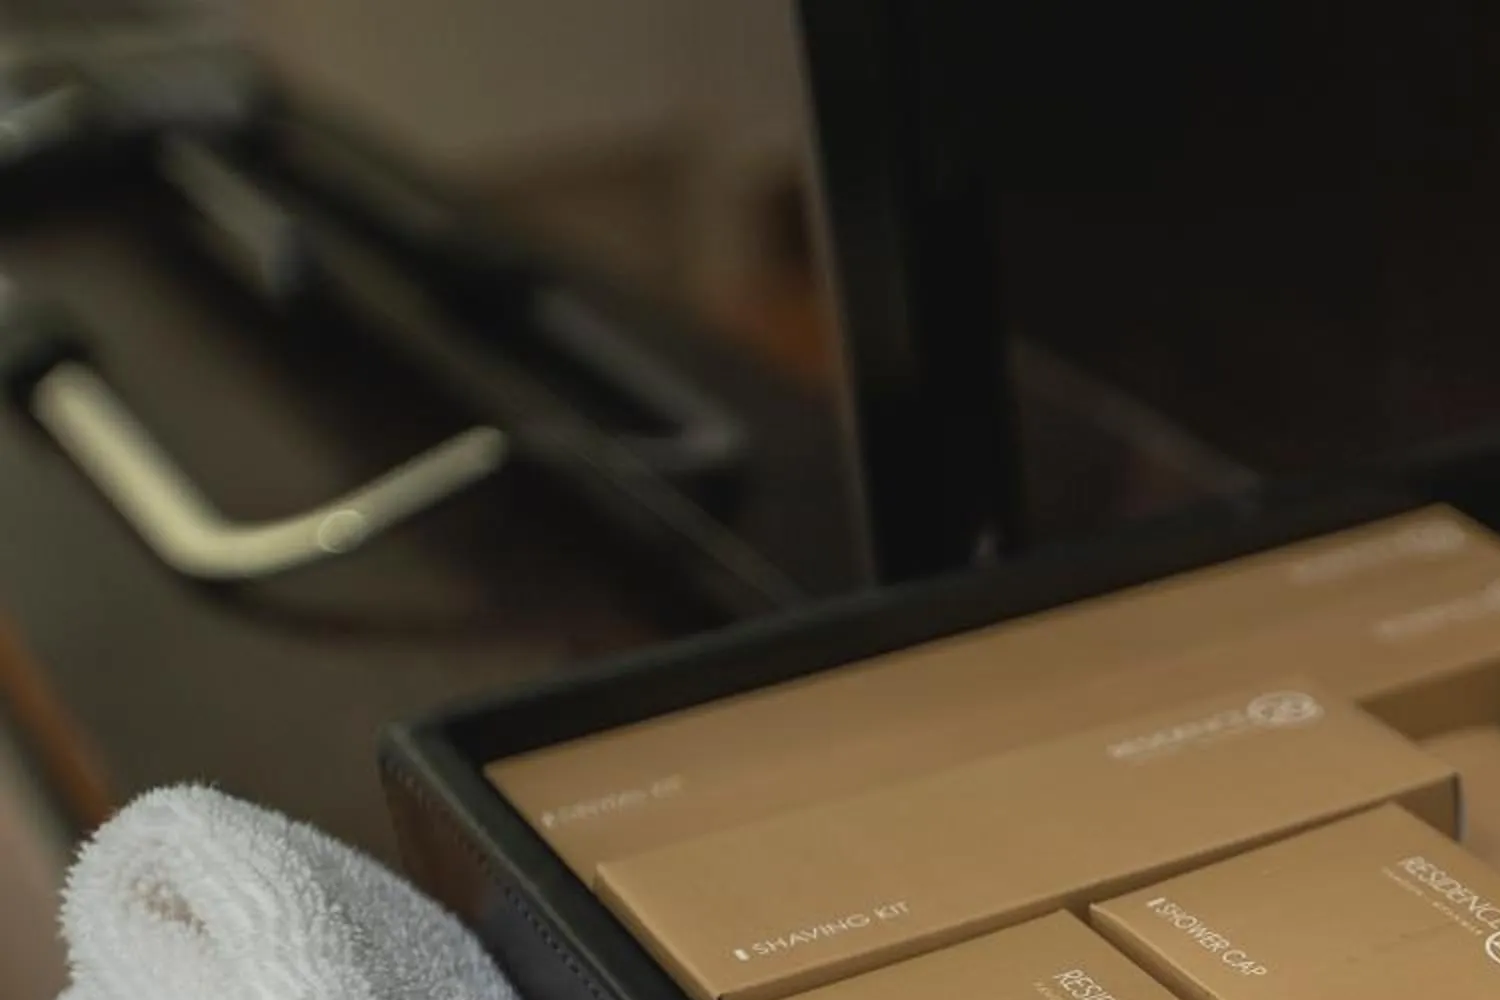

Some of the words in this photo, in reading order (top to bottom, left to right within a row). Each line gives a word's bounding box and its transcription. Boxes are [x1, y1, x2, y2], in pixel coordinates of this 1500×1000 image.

[752, 914, 870, 955] SHAVING
[873, 899, 910, 920] KIT
[1155, 902, 1230, 953] SHOWER
[1222, 949, 1268, 975] CAP
